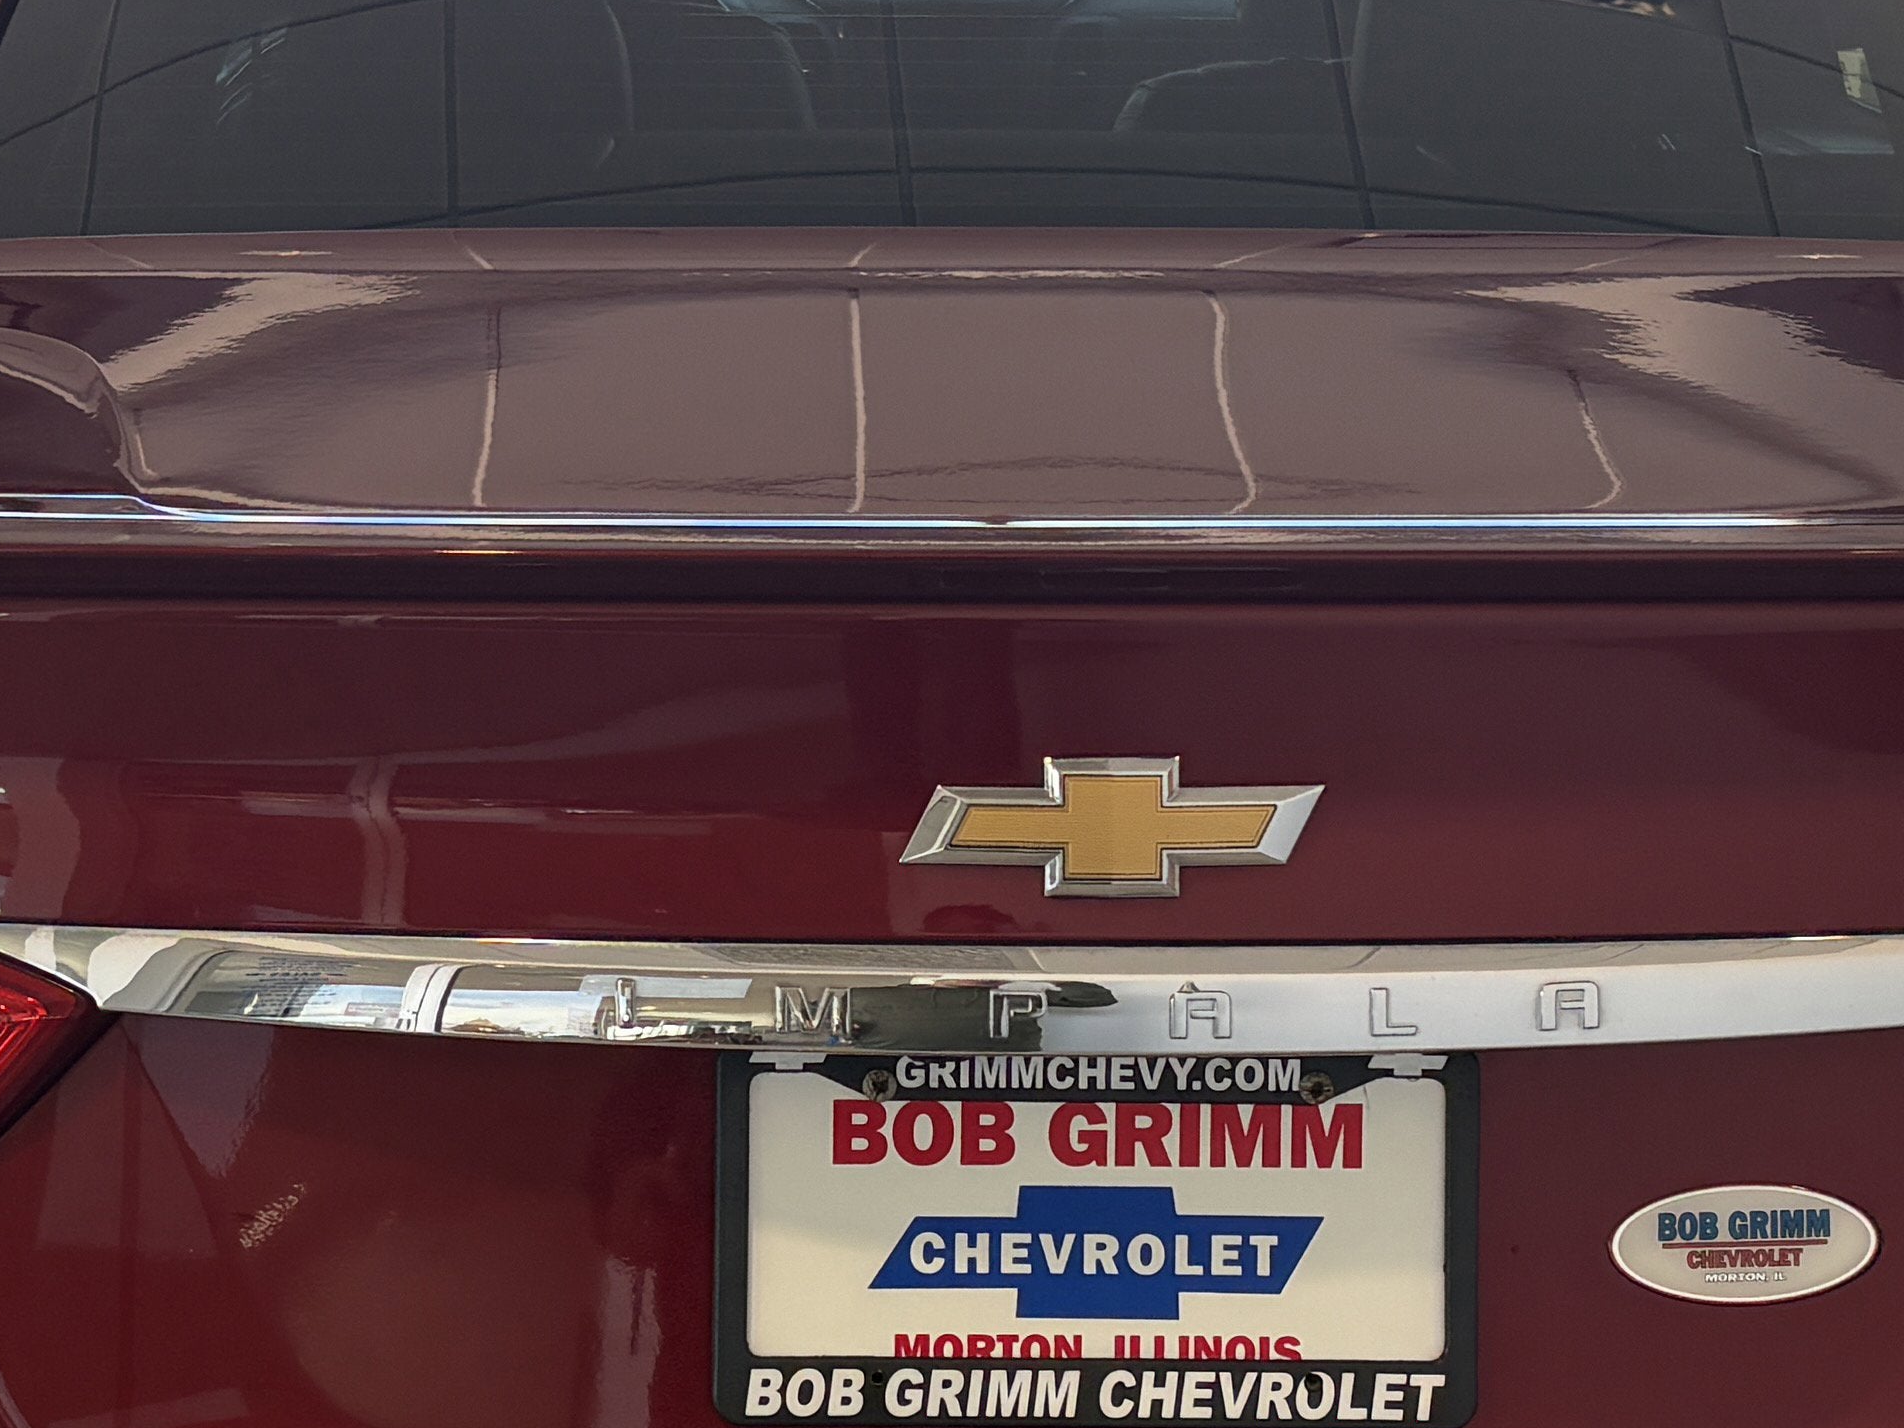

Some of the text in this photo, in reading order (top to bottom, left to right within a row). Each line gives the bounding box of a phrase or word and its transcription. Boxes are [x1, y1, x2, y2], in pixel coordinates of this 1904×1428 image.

[896, 1055, 1301, 1092] GRIMMCHEVY.COM
[832, 1100, 1364, 1169] BOB GRIMM
[1658, 1209, 1831, 1241] BOB GRIMM
[909, 1231, 1278, 1276] CHEVROLET
[1687, 1248, 1803, 1270] CHEVROLET
[745, 1368, 1446, 1422] BOB GRIMM CHEVROLET
